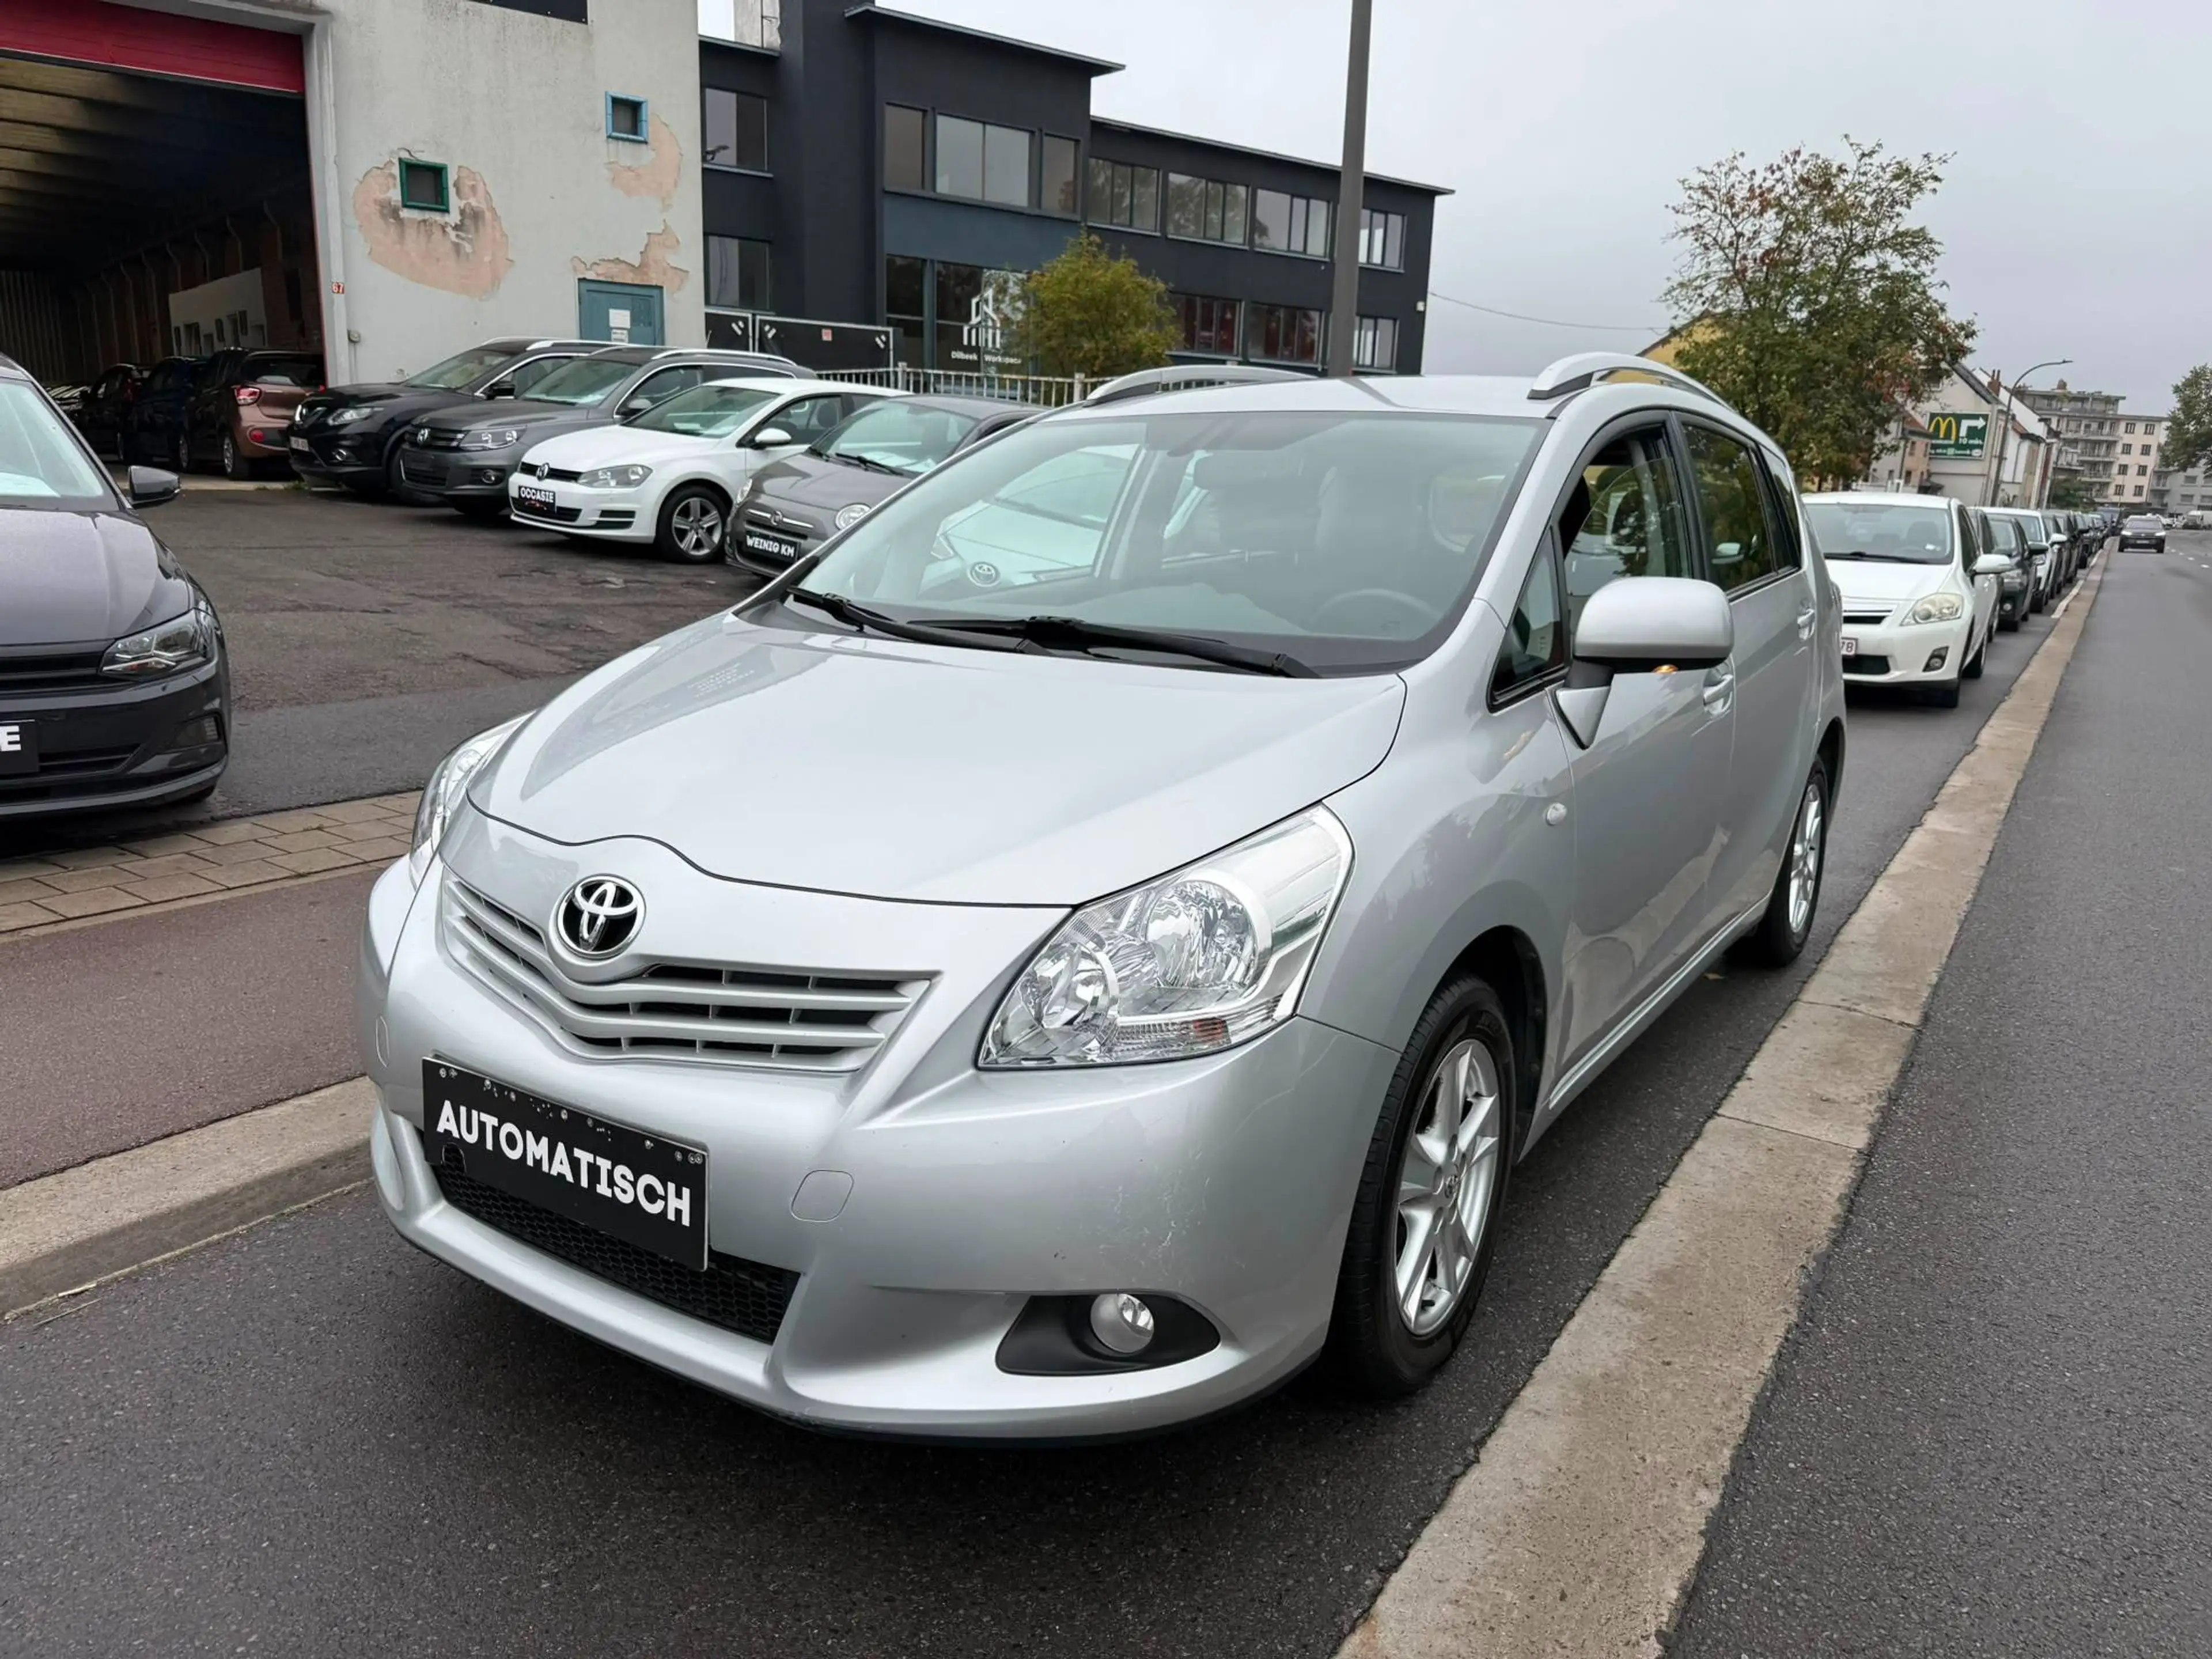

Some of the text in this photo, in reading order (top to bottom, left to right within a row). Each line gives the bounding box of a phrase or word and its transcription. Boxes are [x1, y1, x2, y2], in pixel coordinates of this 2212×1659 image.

[951, 351, 978, 361] Dilbeek
[520, 487, 554, 503] OCCASIE
[746, 535, 795, 558] WEINIG KM
[436, 1100, 690, 1227] AUTOMATISCH
